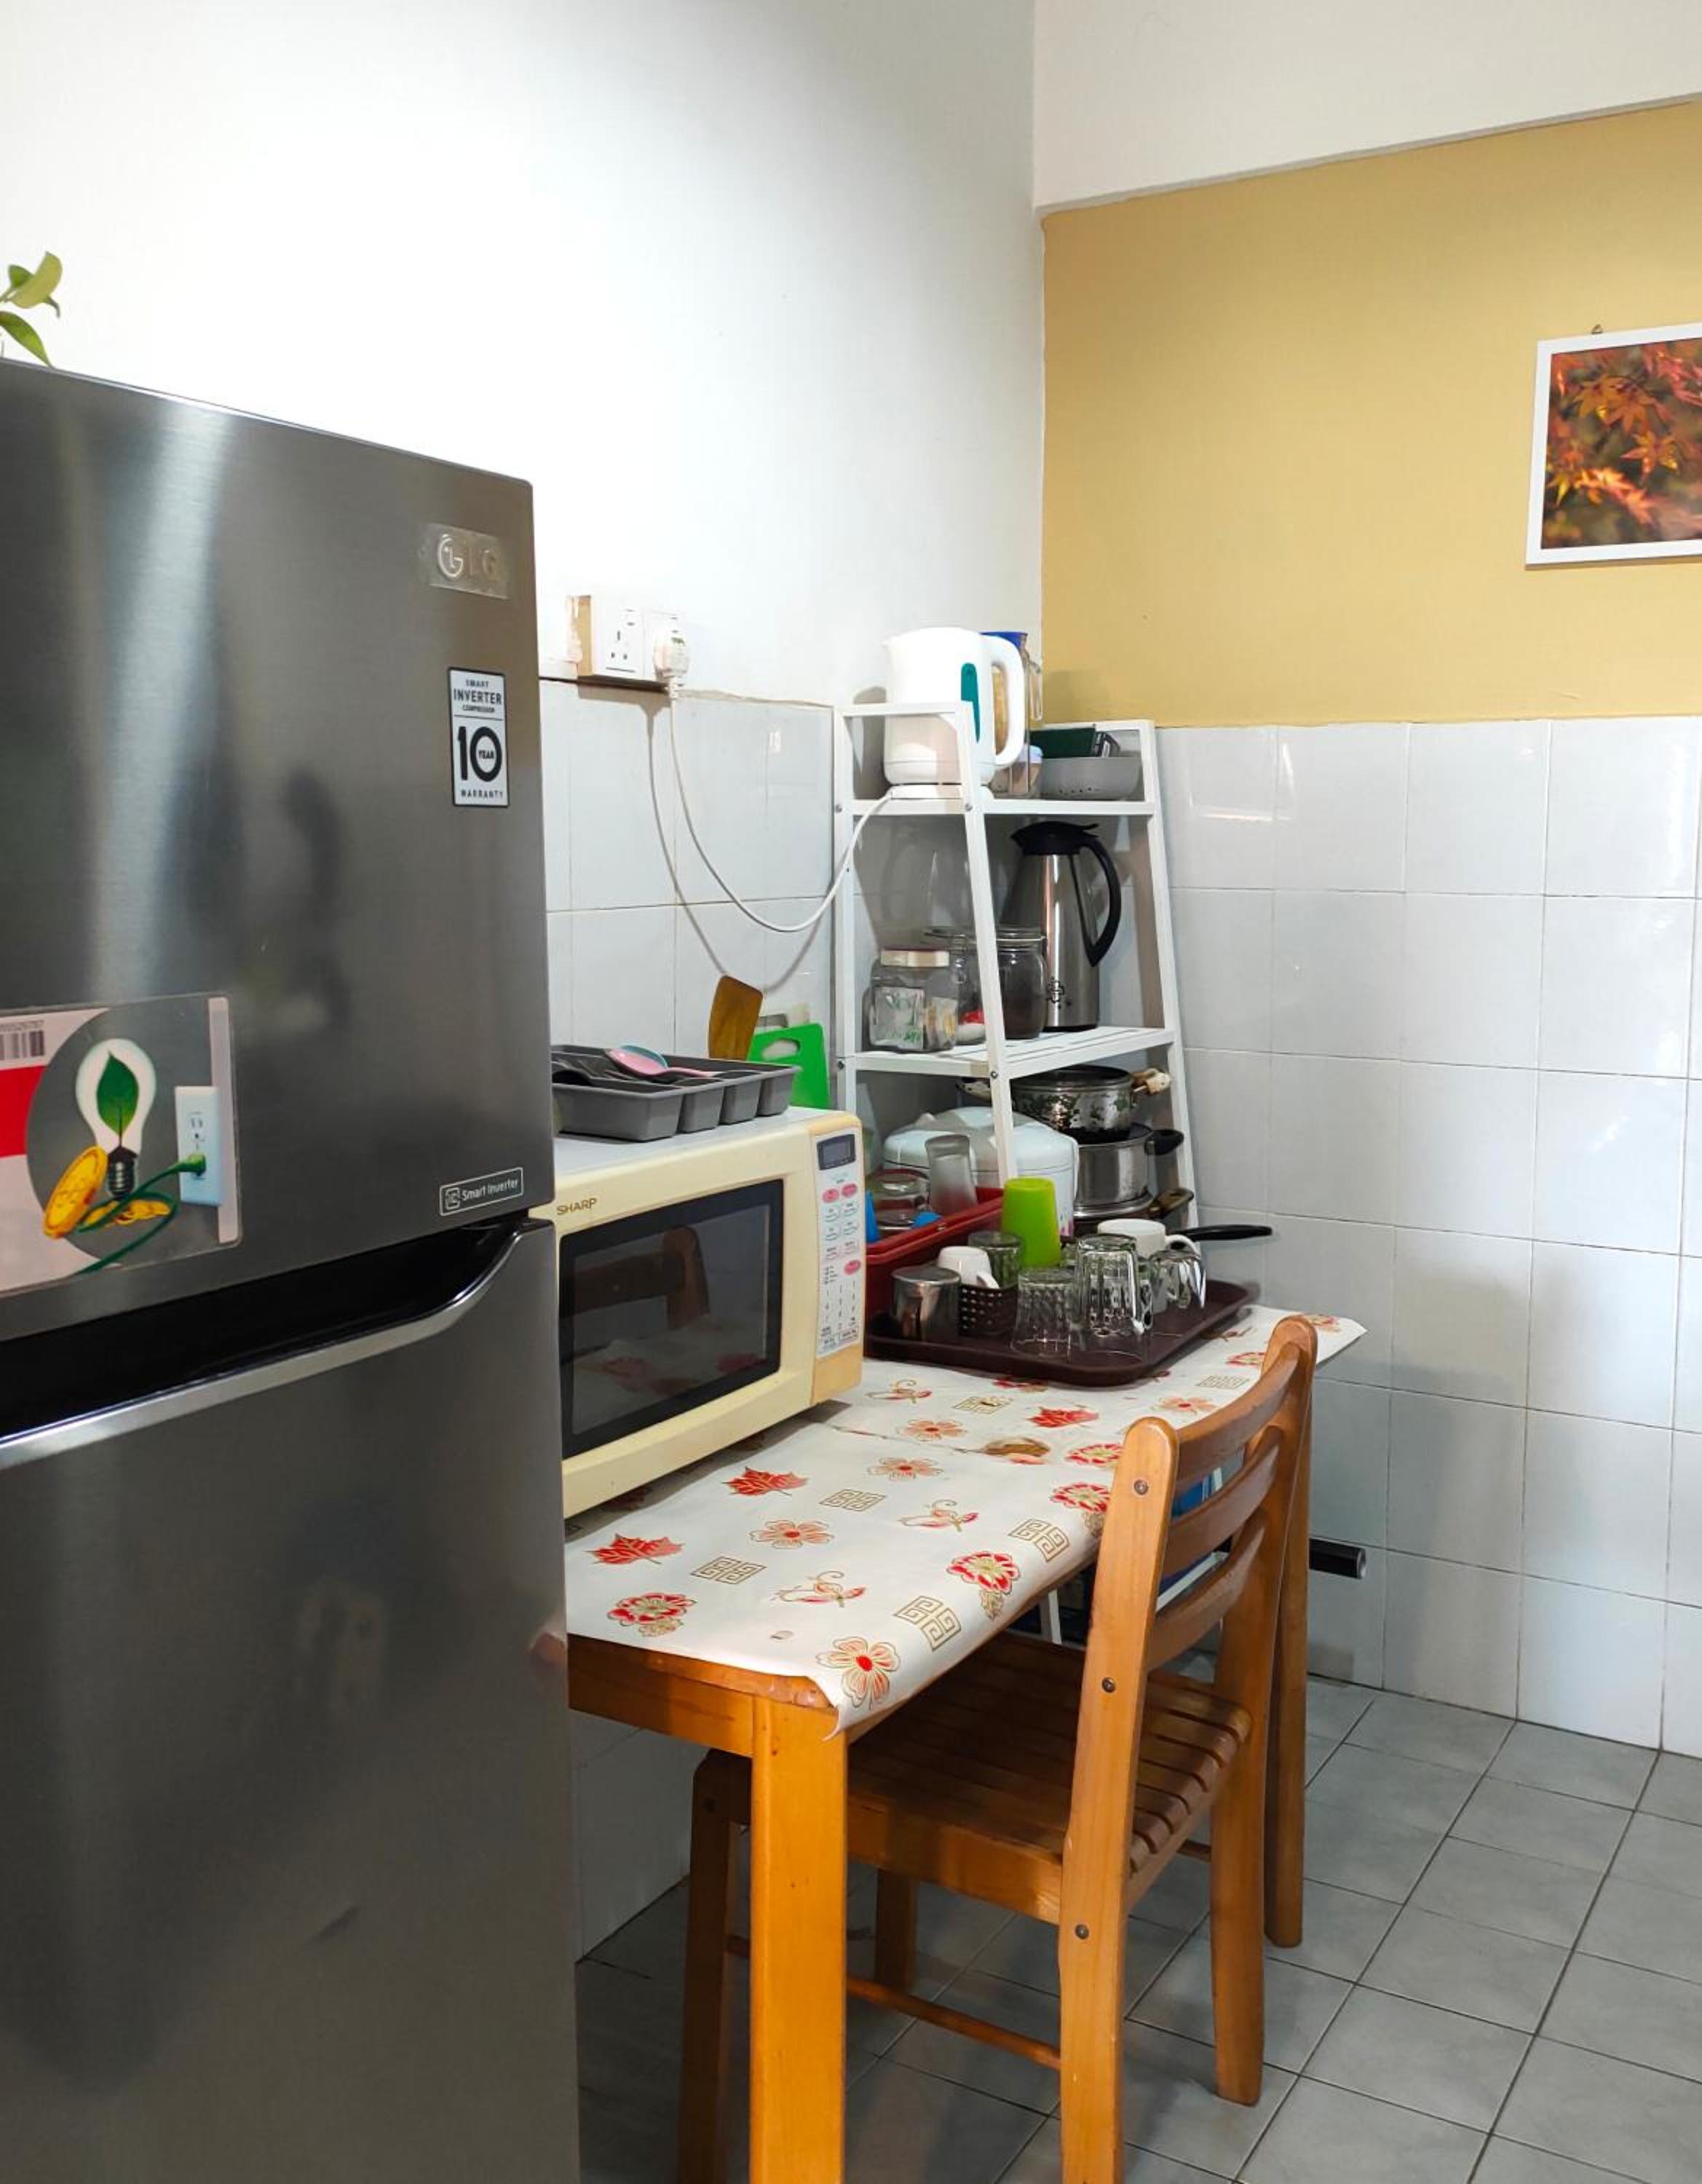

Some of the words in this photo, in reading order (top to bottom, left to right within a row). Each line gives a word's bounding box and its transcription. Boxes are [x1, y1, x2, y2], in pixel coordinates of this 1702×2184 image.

[454, 688, 502, 705] INVERTER
[457, 726, 502, 782] 10
[478, 750, 495, 759] YEAR
[461, 789, 503, 799] WARRANTY
[462, 1185, 486, 1201] Smart
[487, 1178, 518, 1194] Inverter
[556, 1198, 597, 1215] SHARP
